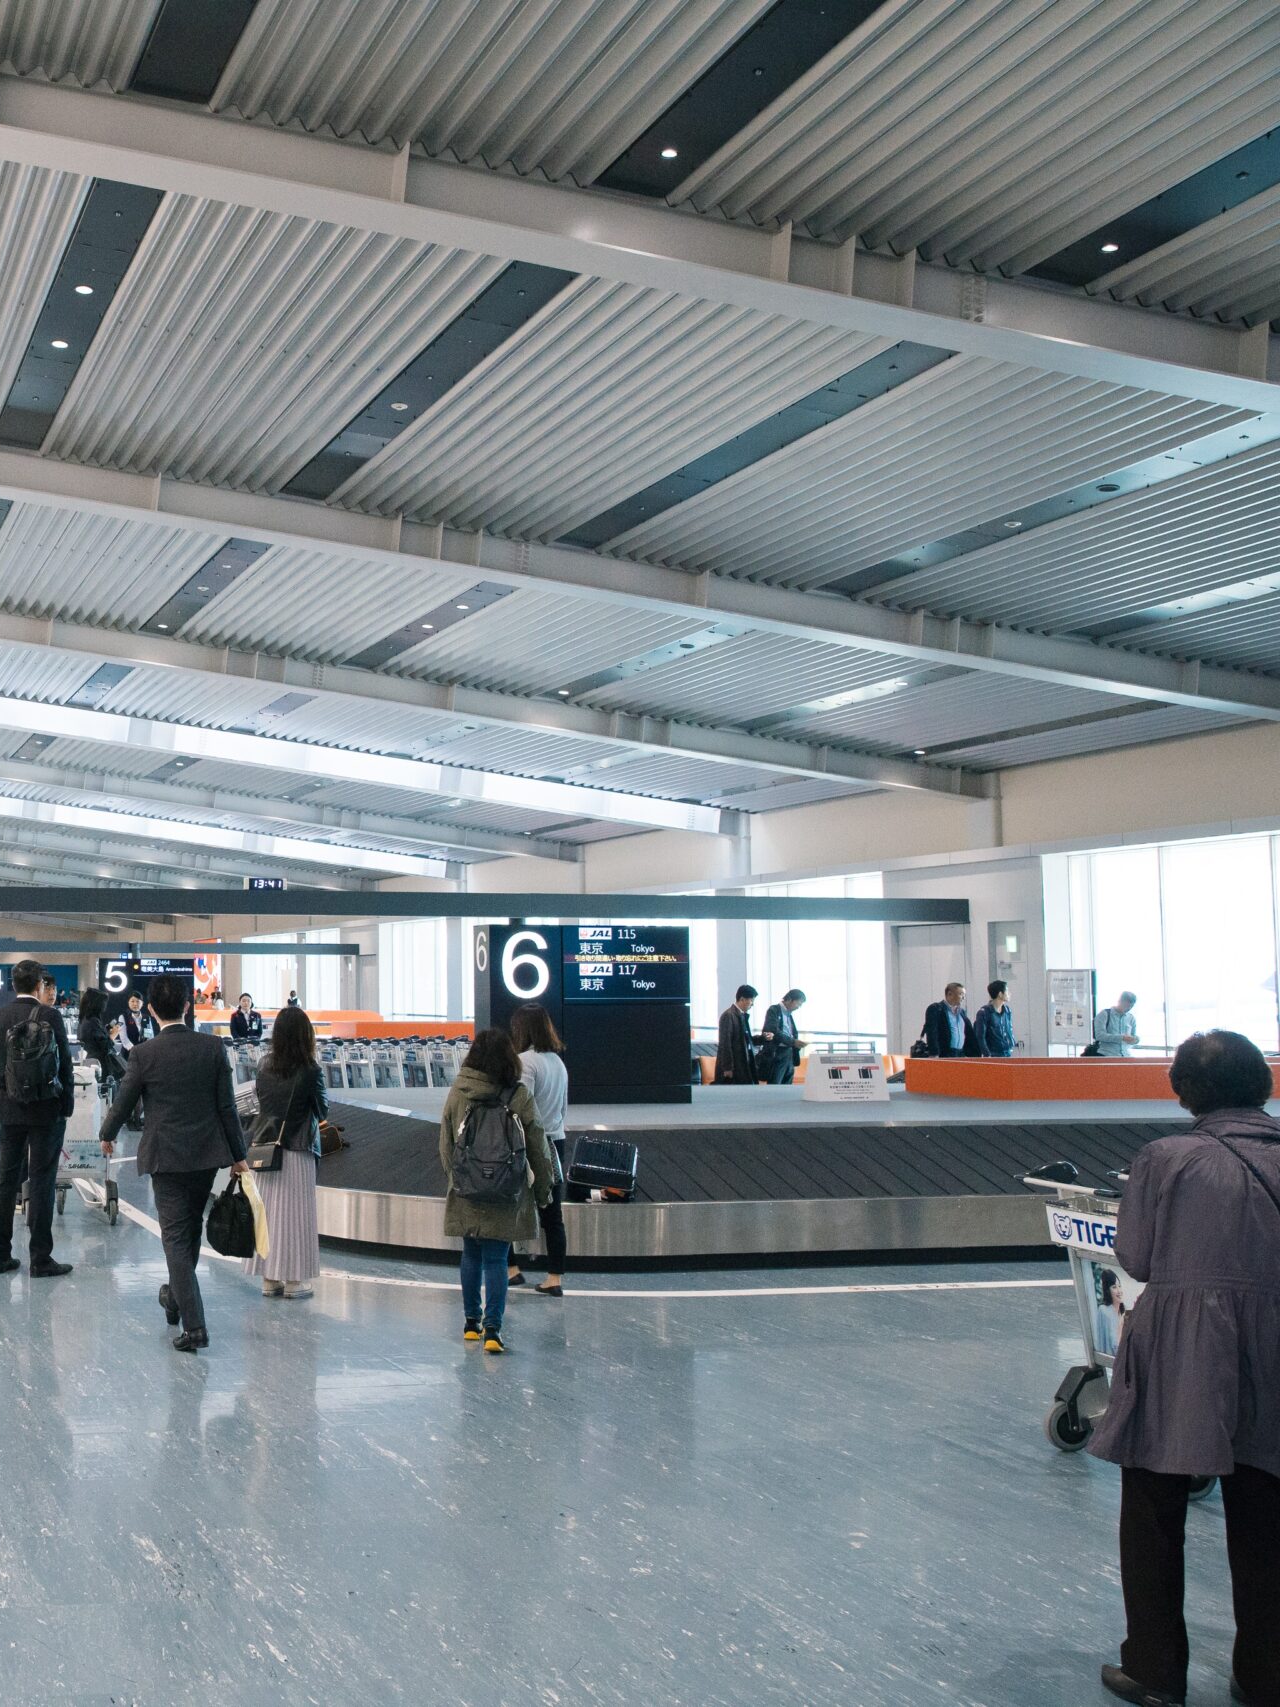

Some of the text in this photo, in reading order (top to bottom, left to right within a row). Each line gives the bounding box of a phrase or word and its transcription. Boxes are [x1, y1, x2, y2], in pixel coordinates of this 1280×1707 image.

[254, 879, 282, 889] 13:41
[590, 929, 637, 939] JAL 115
[579, 942, 655, 955] 東京 Tokyo
[501, 930, 550, 1000] 6
[618, 965, 637, 975] 117
[103, 961, 128, 992] 5
[580, 977, 656, 991] 東京 Tokyo
[1071, 1218, 1117, 1249] TIGE
